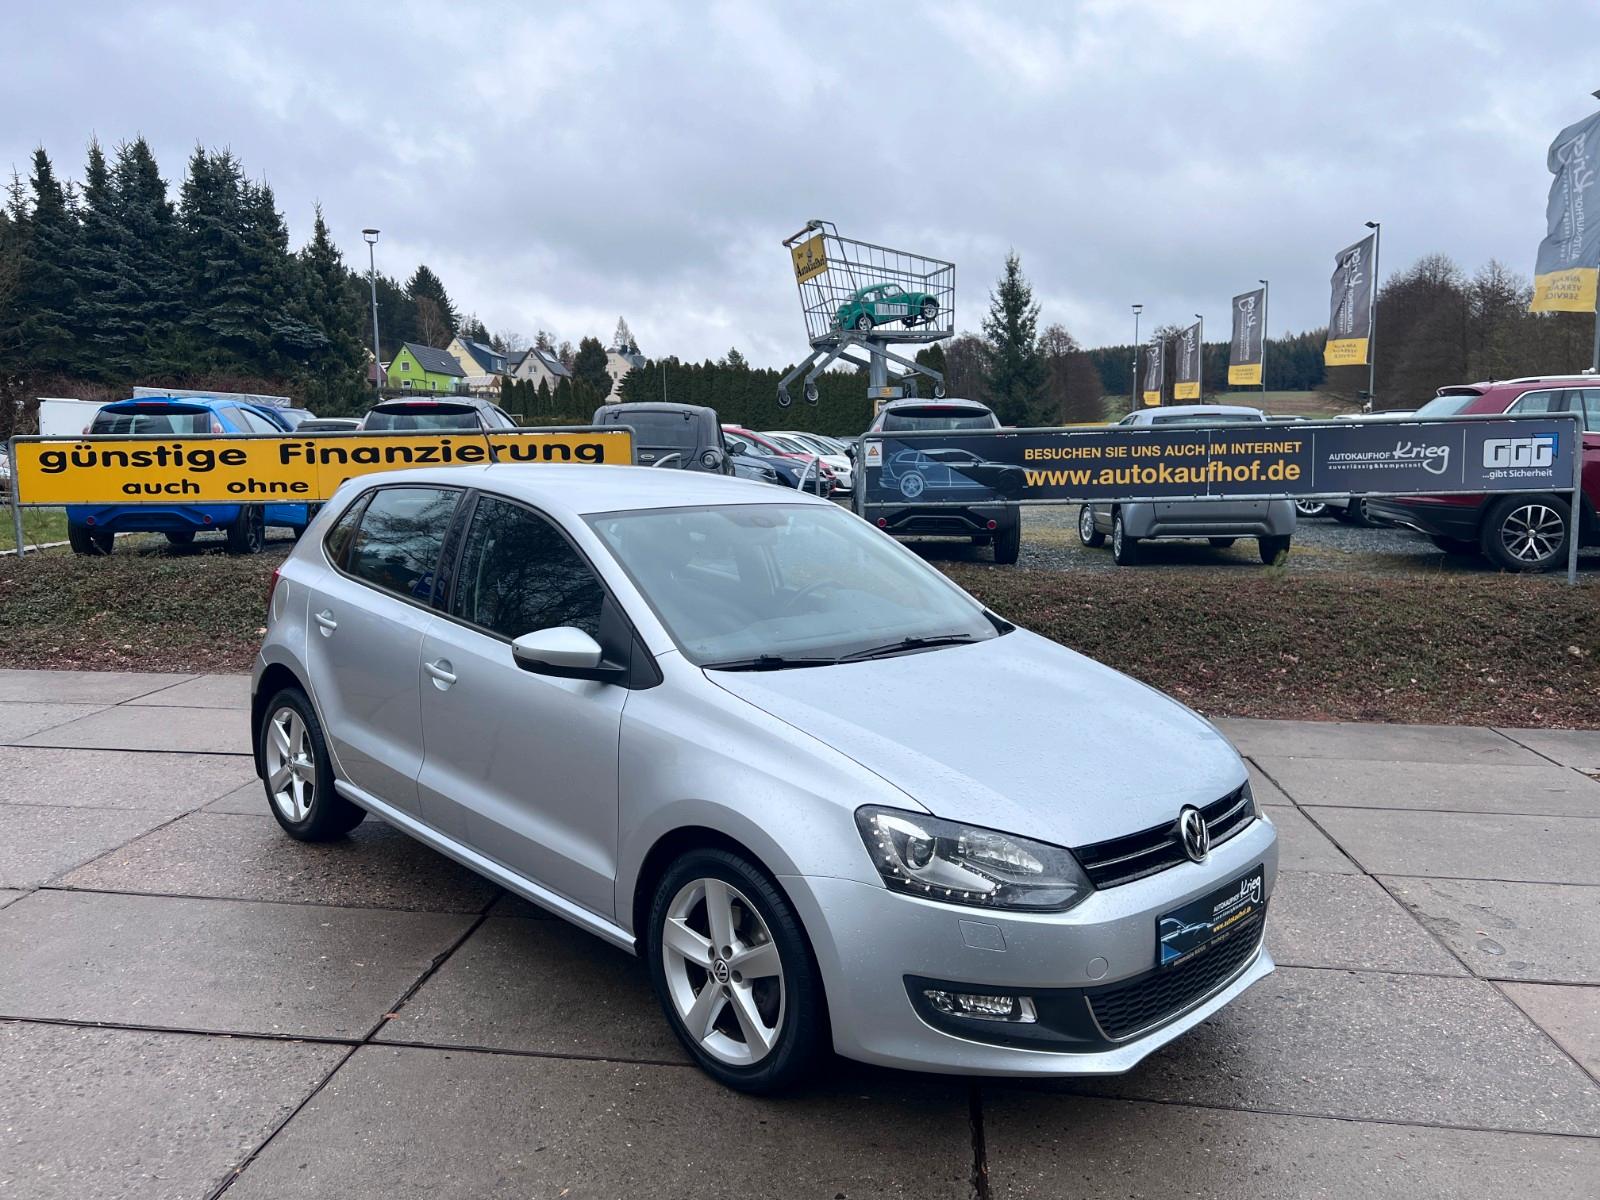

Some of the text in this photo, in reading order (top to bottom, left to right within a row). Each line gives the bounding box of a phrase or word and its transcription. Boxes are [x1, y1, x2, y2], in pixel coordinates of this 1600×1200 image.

[38, 439, 605, 474] günstige Finanzierung
[1024, 441, 1302, 460] BESUCHEN SIE UNS AUCH IM INTERNET
[1328, 440, 1450, 475] AUTOKAUFHOF Krieg
[121, 477, 310, 494] auch ohne
[1024, 459, 1301, 487] www.autokaufhof.de
[1509, 468, 1553, 478] Sicherheit
[1240, 876, 1261, 903] Krieg
